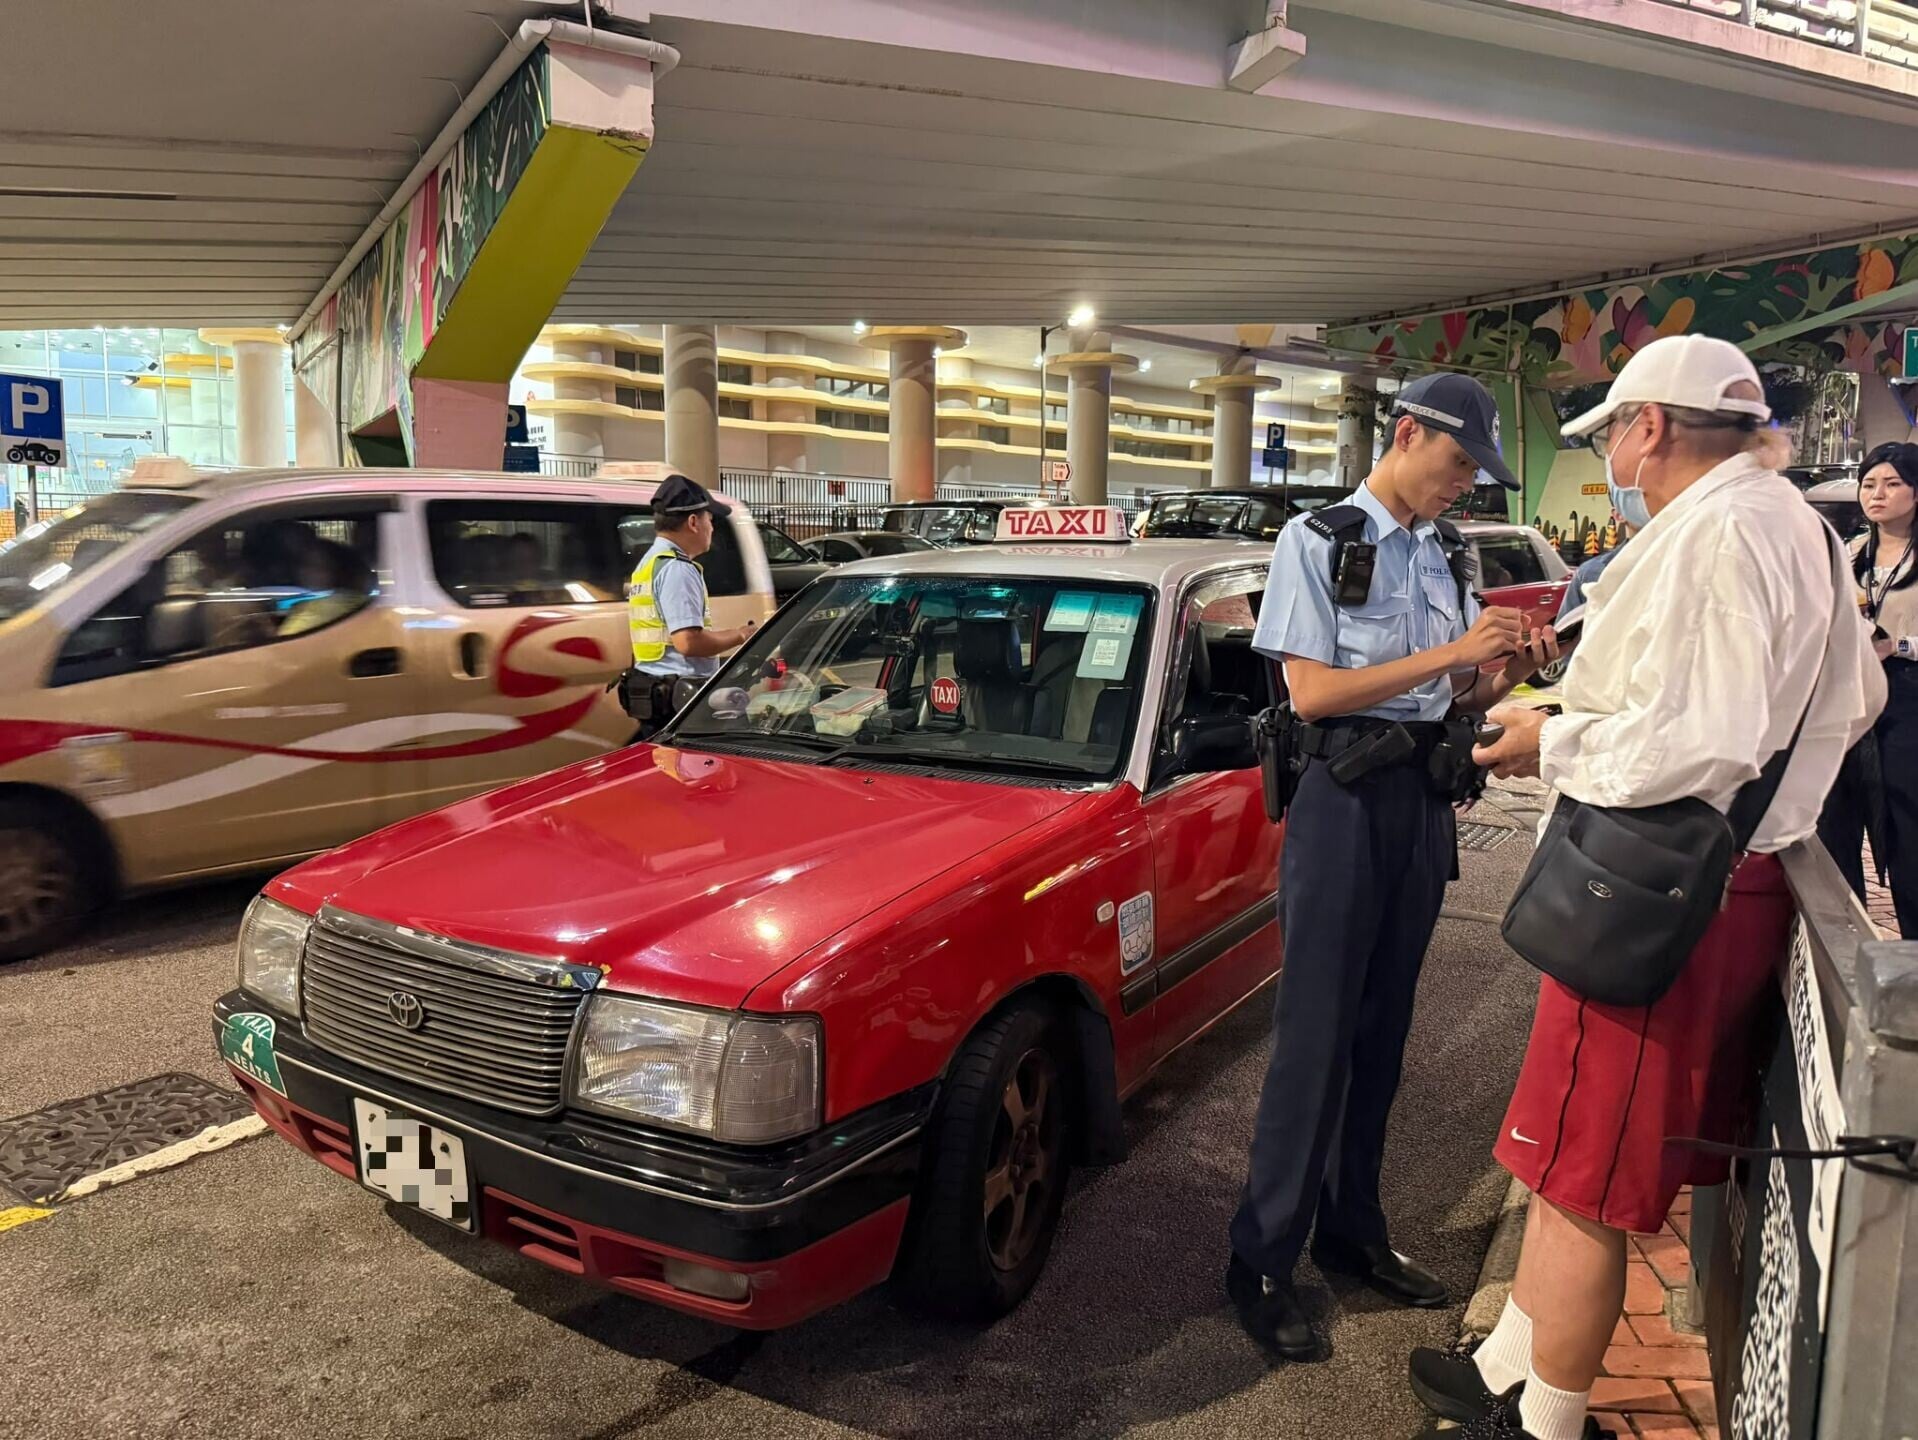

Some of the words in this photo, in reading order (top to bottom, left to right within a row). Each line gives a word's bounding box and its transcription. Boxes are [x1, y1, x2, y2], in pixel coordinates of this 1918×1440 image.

[11, 382, 50, 430] P
[1269, 425, 1282, 446] P
[1005, 509, 1106, 535] TAXI
[932, 686, 957, 704] TAXI
[241, 1015, 272, 1038] TAXI
[242, 1033, 255, 1060] 4
[232, 1051, 272, 1084] SEATS
